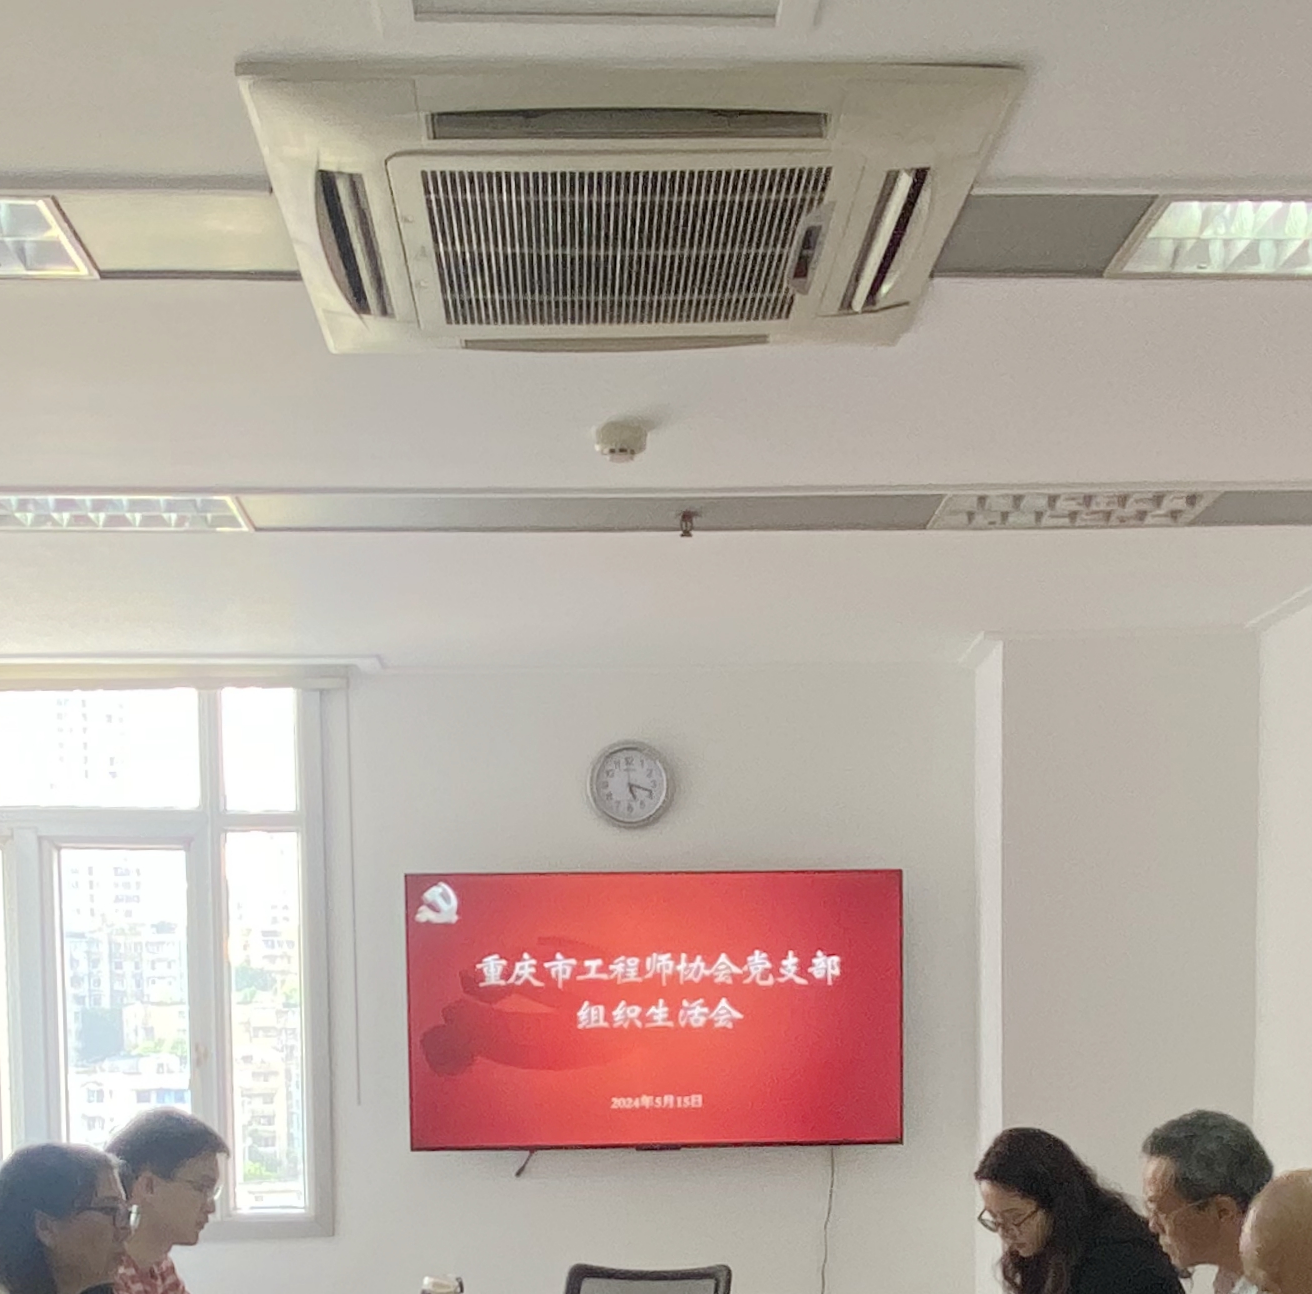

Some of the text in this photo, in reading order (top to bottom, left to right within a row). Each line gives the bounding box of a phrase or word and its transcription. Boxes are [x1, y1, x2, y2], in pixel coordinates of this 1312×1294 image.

[475, 948, 843, 991] 重庆市工程师协会党支部
[575, 996, 745, 1031] 组织生活会
